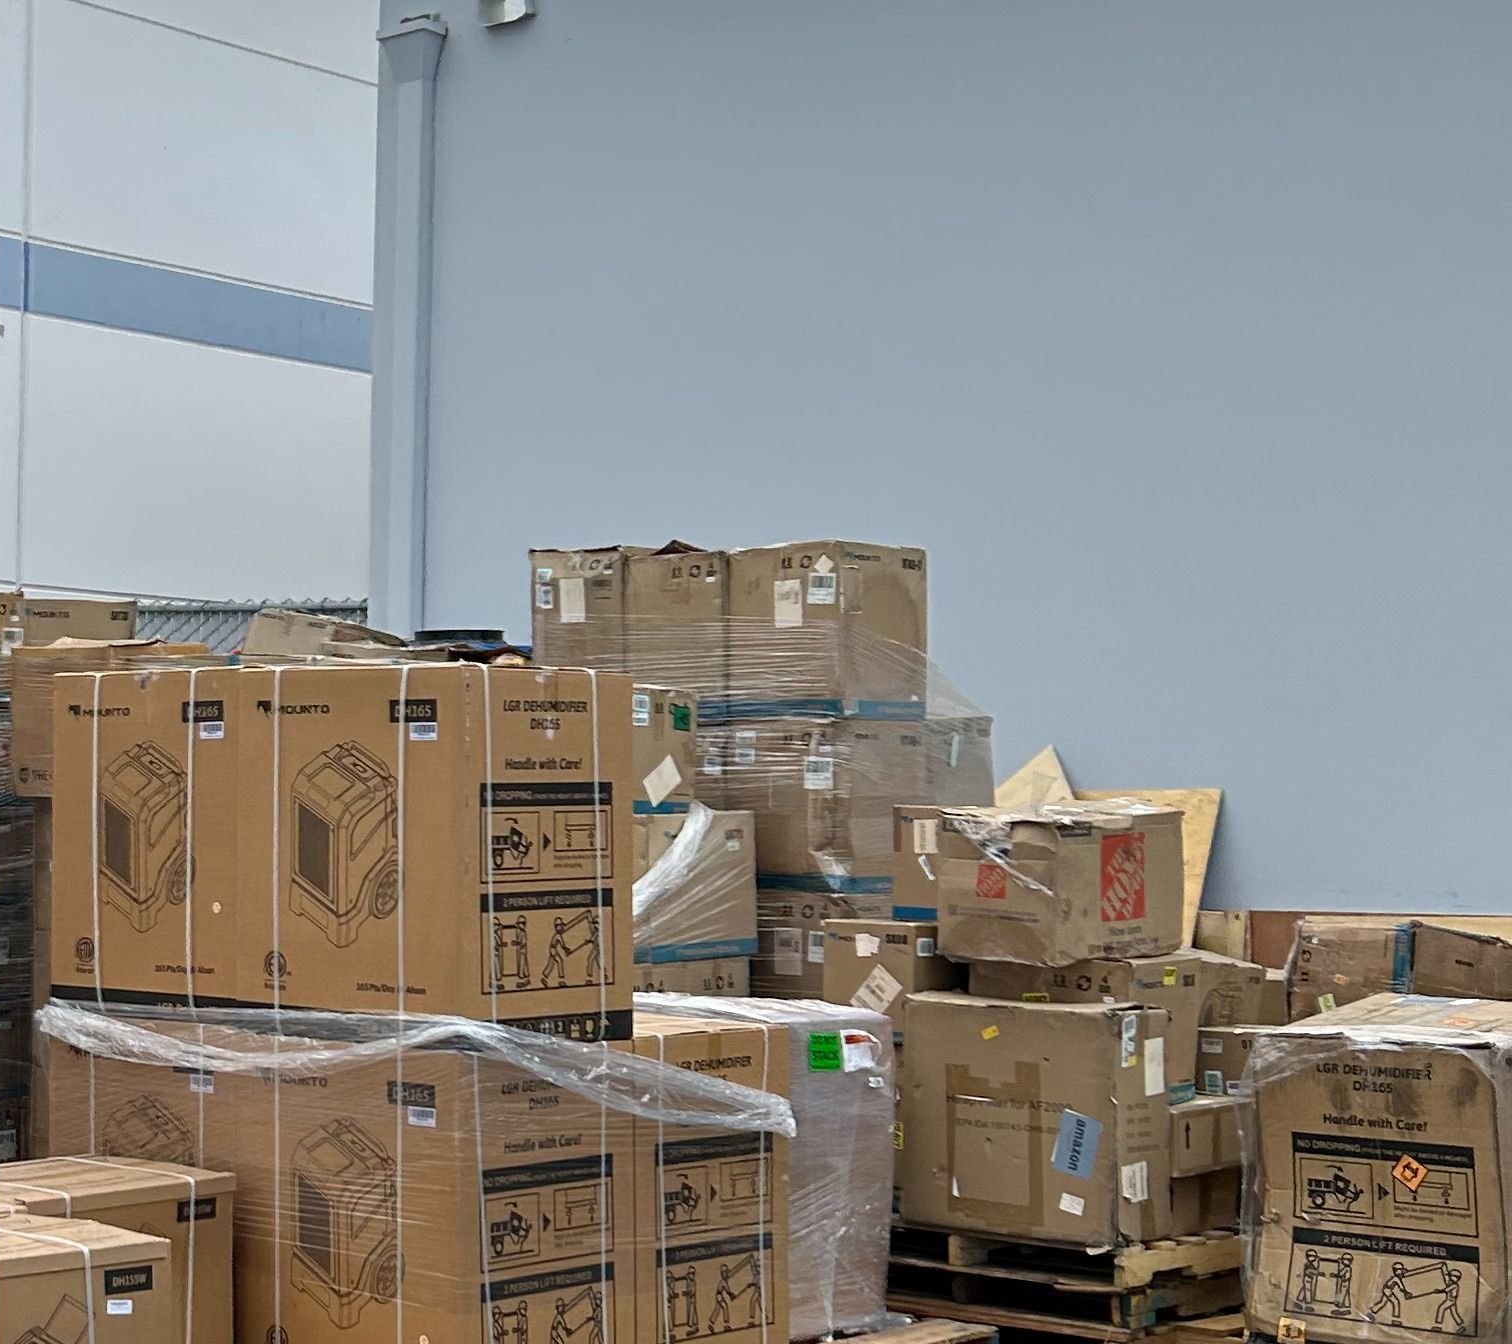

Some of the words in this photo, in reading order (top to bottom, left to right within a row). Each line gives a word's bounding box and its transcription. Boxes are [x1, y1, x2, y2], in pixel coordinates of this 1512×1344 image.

[82, 707, 131, 718] MUNTO
[503, 700, 521, 712] LGR
[523, 700, 589, 713] DEHUMIDIFIER
[505, 758, 536, 770] Handle
[539, 758, 557, 770] with
[559, 757, 583, 770] Care!
[1317, 1062, 1339, 1074] LGR
[1343, 1062, 1432, 1081] DEHUMIDIFIER
[1323, 1113, 1365, 1127] Handle
[1367, 1116, 1393, 1130] with
[1396, 1119, 1428, 1133] Care!
[504, 1138, 536, 1154] Handle
[538, 1136, 557, 1150] with
[1067, 1118, 1088, 1171] amazon
[1296, 1139, 1311, 1149] NO
[1313, 1140, 1361, 1153] DROPPING
[1331, 1235, 1371, 1248] PERSON
[1394, 1241, 1447, 1257] REQUIRED
[112, 1273, 148, 1288] DH155W
